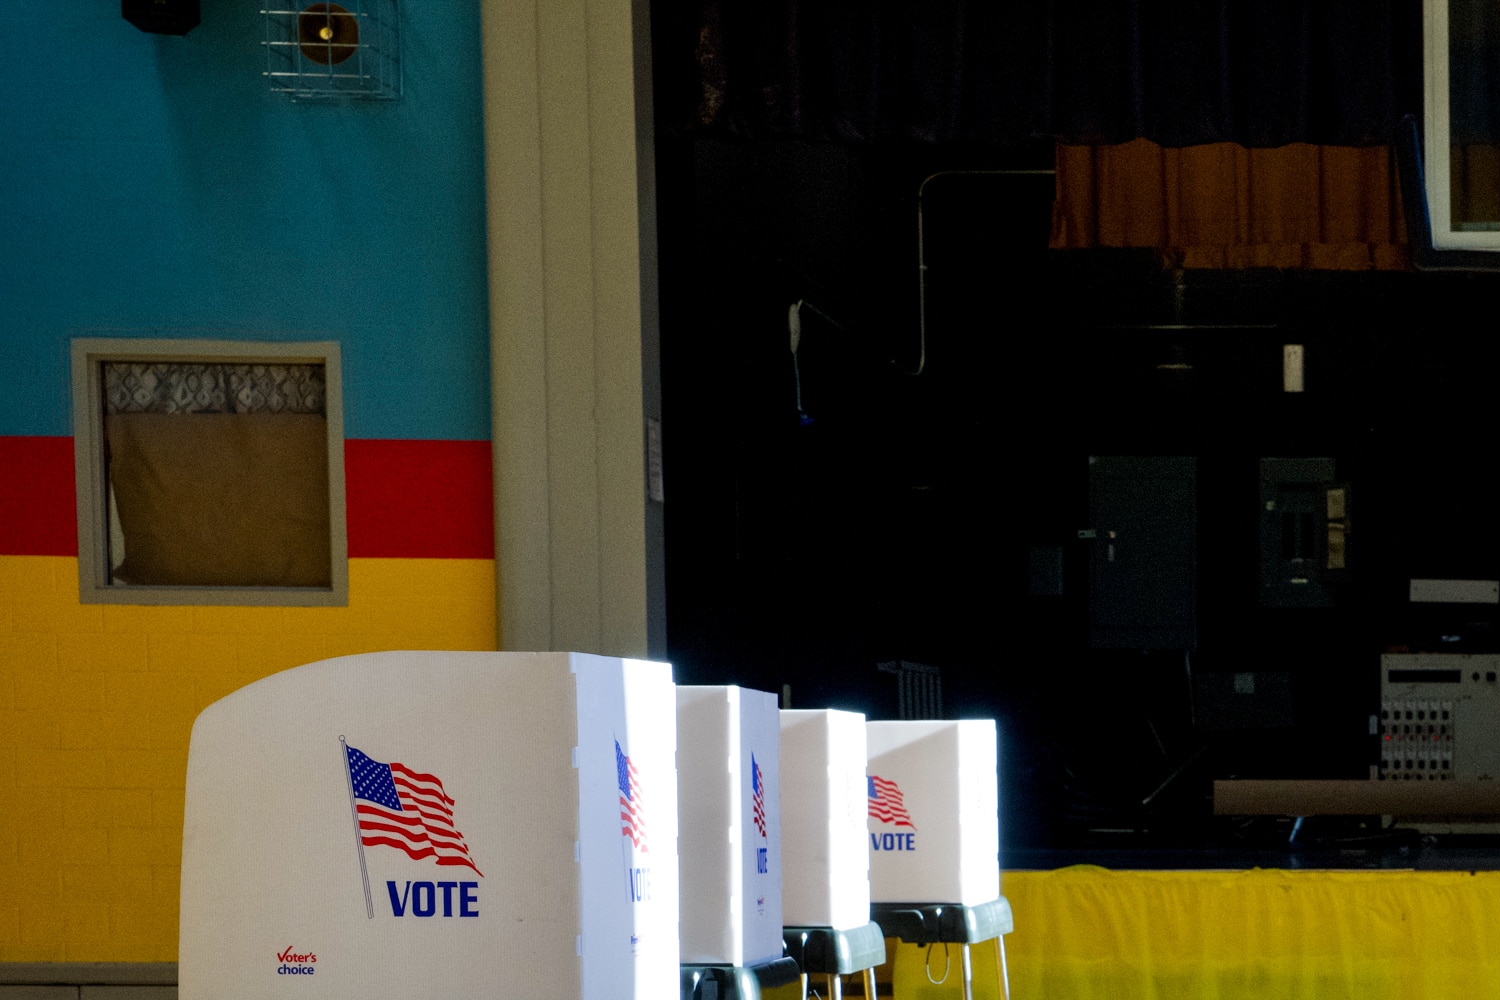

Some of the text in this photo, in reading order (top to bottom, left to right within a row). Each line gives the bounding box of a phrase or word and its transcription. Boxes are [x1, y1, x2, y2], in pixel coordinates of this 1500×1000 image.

[871, 832, 915, 851] VOTE
[386, 881, 479, 917] VOTE
[276, 945, 317, 963] Voter's
[277, 964, 315, 975] choice
